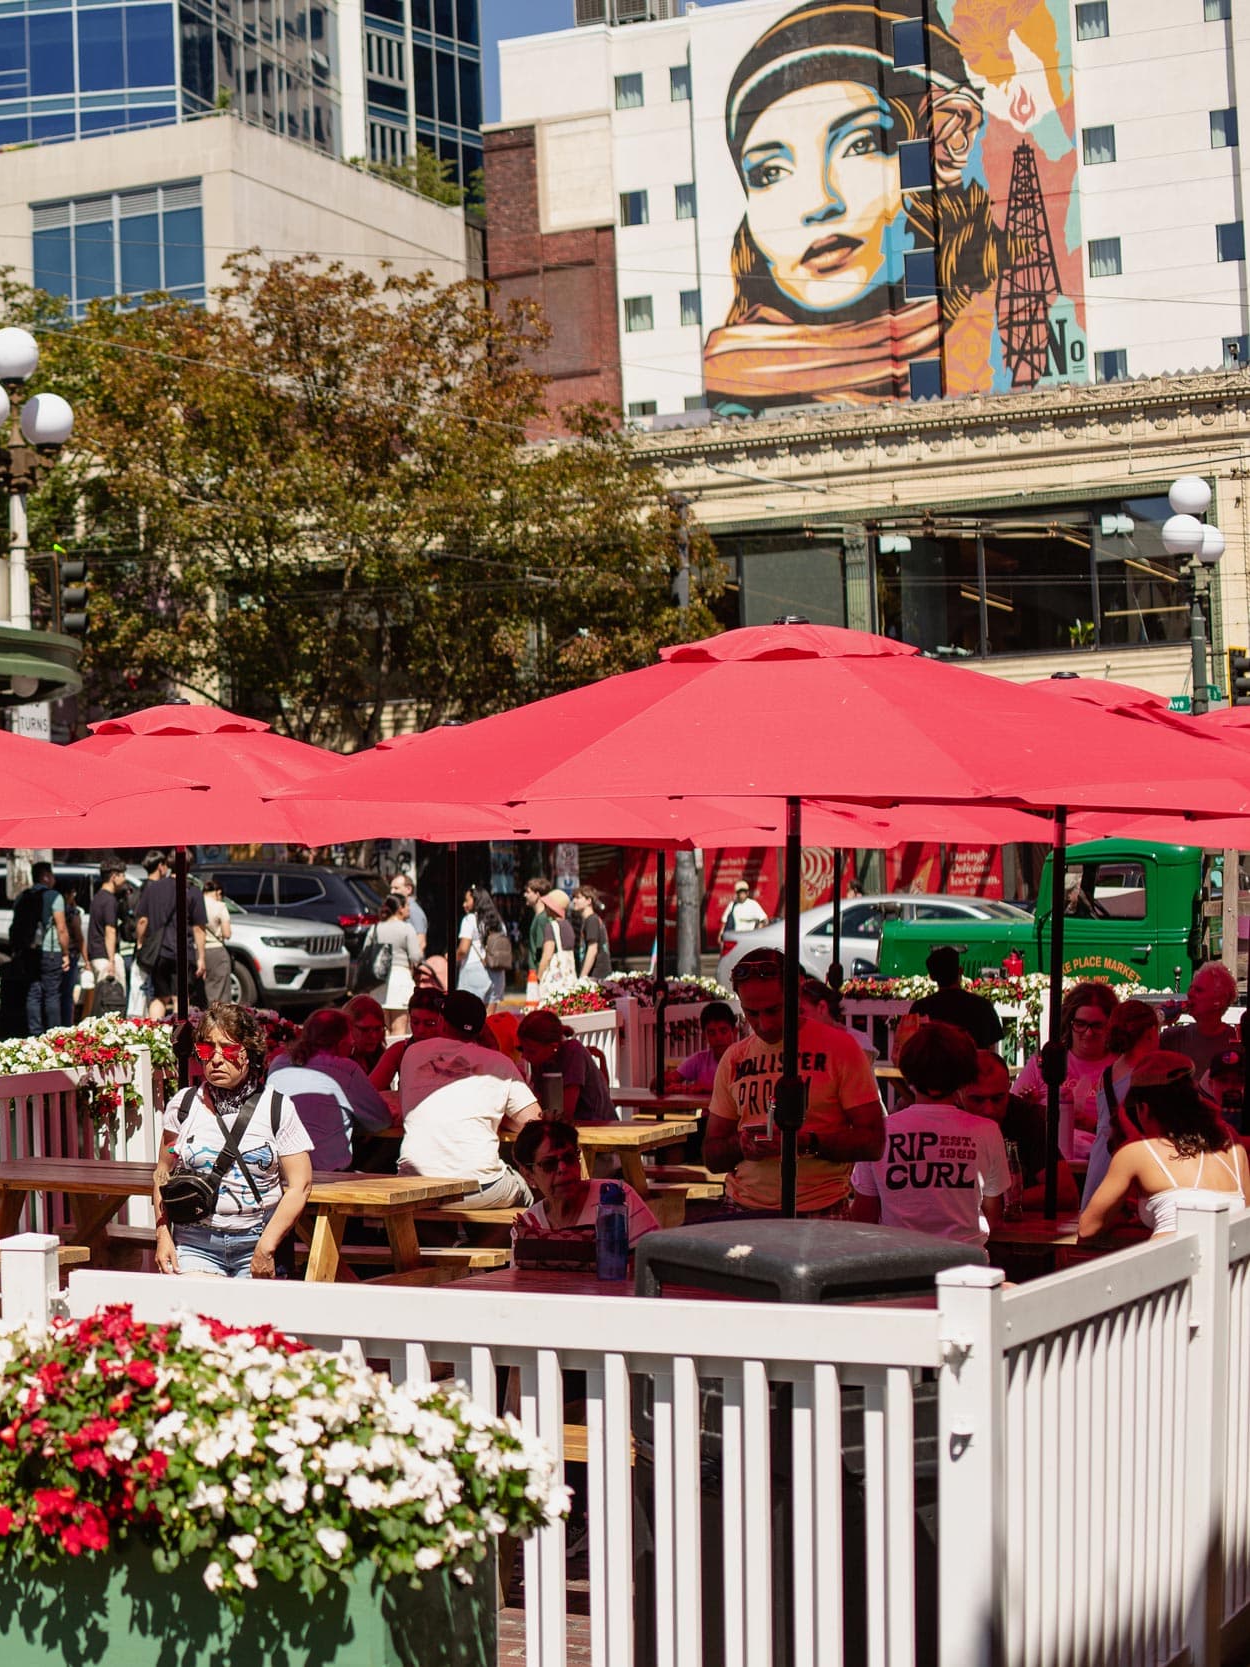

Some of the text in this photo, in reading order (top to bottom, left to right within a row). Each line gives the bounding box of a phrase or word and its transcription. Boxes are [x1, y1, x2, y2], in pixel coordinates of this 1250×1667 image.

[1168, 701, 1185, 710] Ave
[20, 716, 47, 732] TURNS
[951, 874, 1000, 886] Ice Cream.
[1072, 956, 1102, 969] PLACE
[1103, 957, 1142, 983] MARKET
[887, 1131, 976, 1163] RIP EST.
[939, 1148, 977, 1160] 1969
[885, 1162, 975, 1190] CURL
